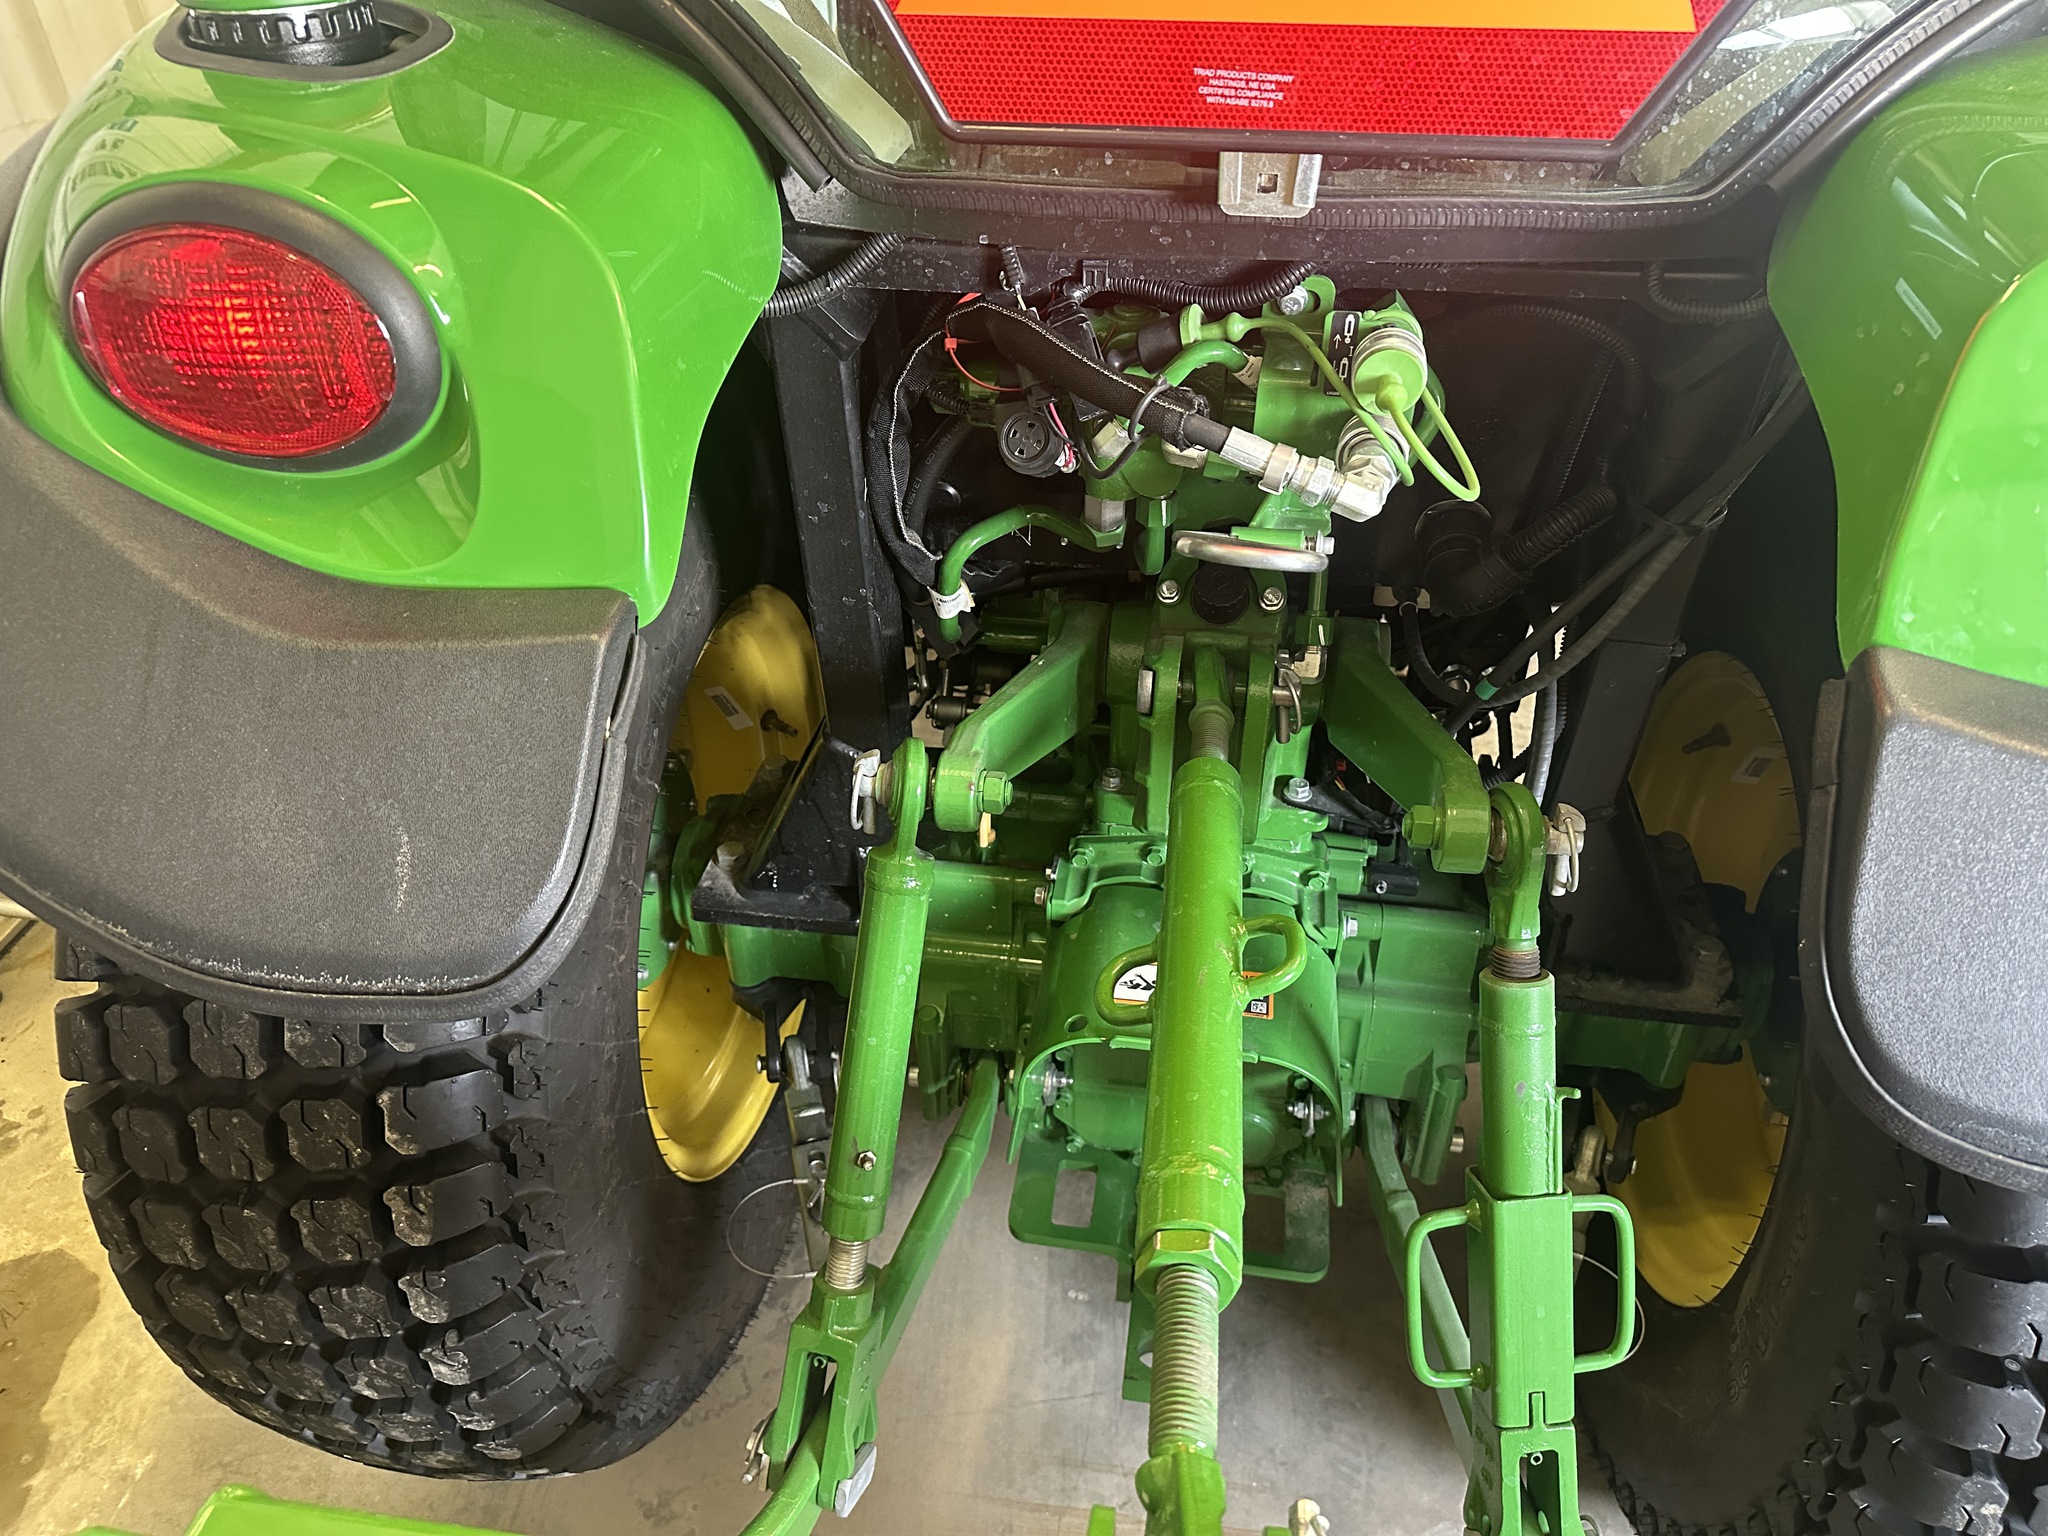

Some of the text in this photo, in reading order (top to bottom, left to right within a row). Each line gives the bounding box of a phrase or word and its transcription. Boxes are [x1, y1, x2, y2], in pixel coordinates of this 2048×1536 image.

[1193, 68, 1294, 83] TRIAD PRODUCTS COMPANY
[1248, 81, 1259, 89] NE
[1260, 82, 1276, 90] USA
[1198, 86, 1284, 100] CERTIFIES COMPLIANCE
[1206, 96, 1225, 104] WITH
[1225, 97, 1250, 106] ASABE
